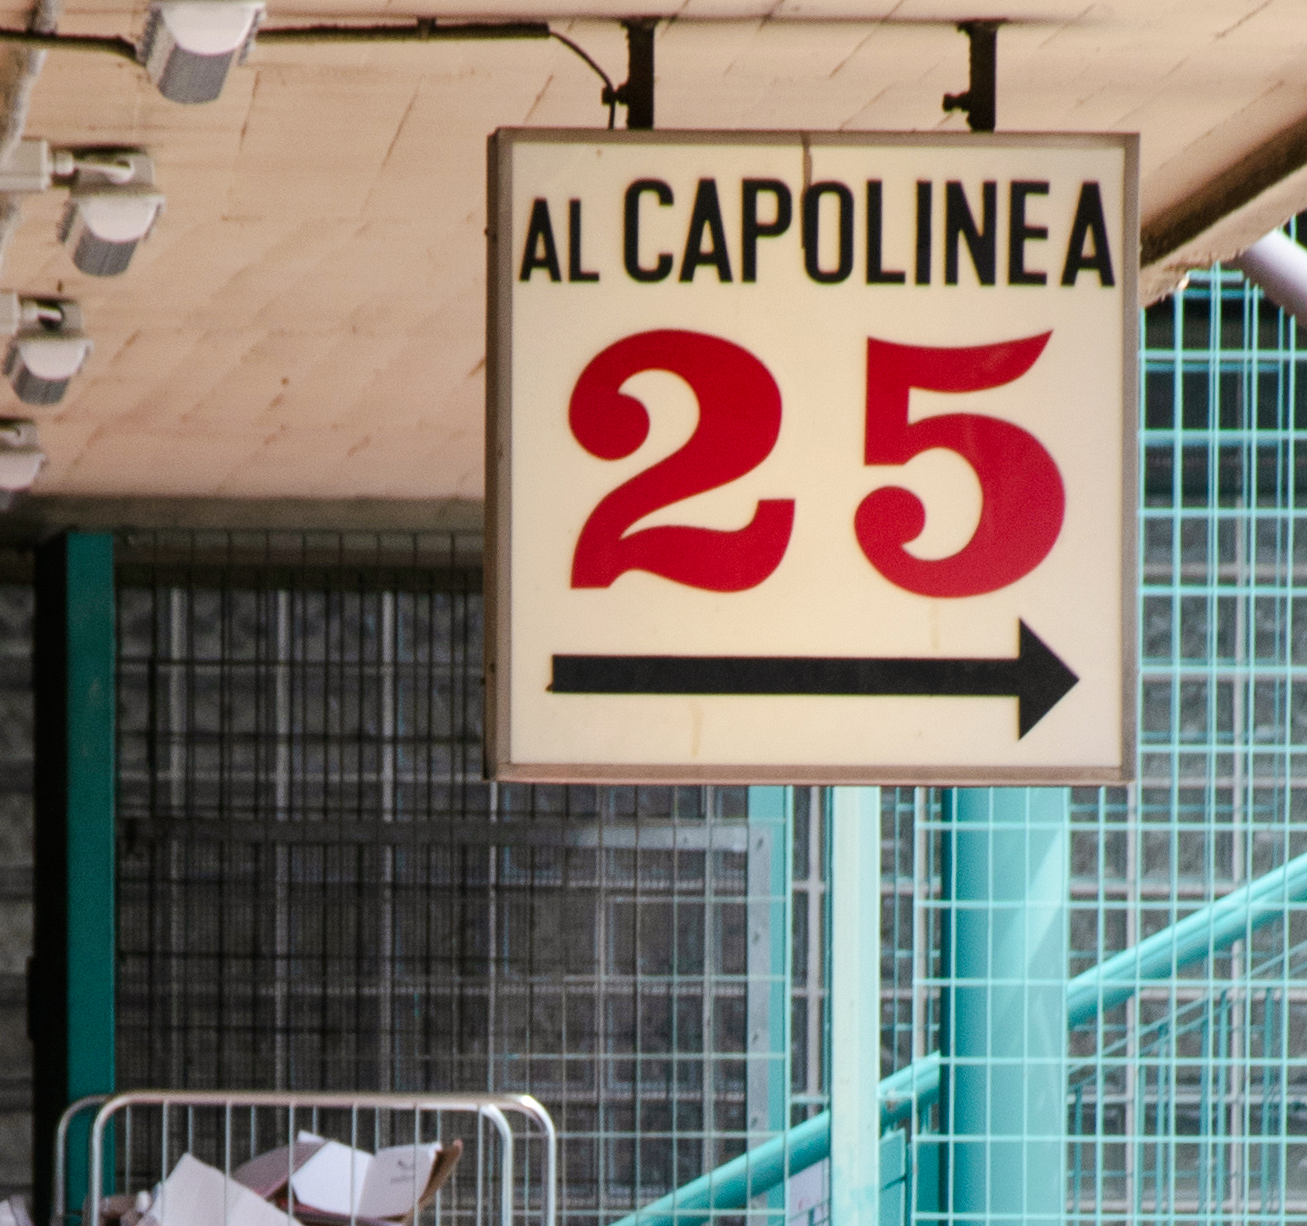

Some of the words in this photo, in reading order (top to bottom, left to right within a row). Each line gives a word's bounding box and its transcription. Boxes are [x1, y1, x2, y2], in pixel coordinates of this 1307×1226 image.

[518, 197, 601, 284] AL
[622, 178, 1116, 288] CAPOLINEA
[567, 328, 1067, 600] 25
